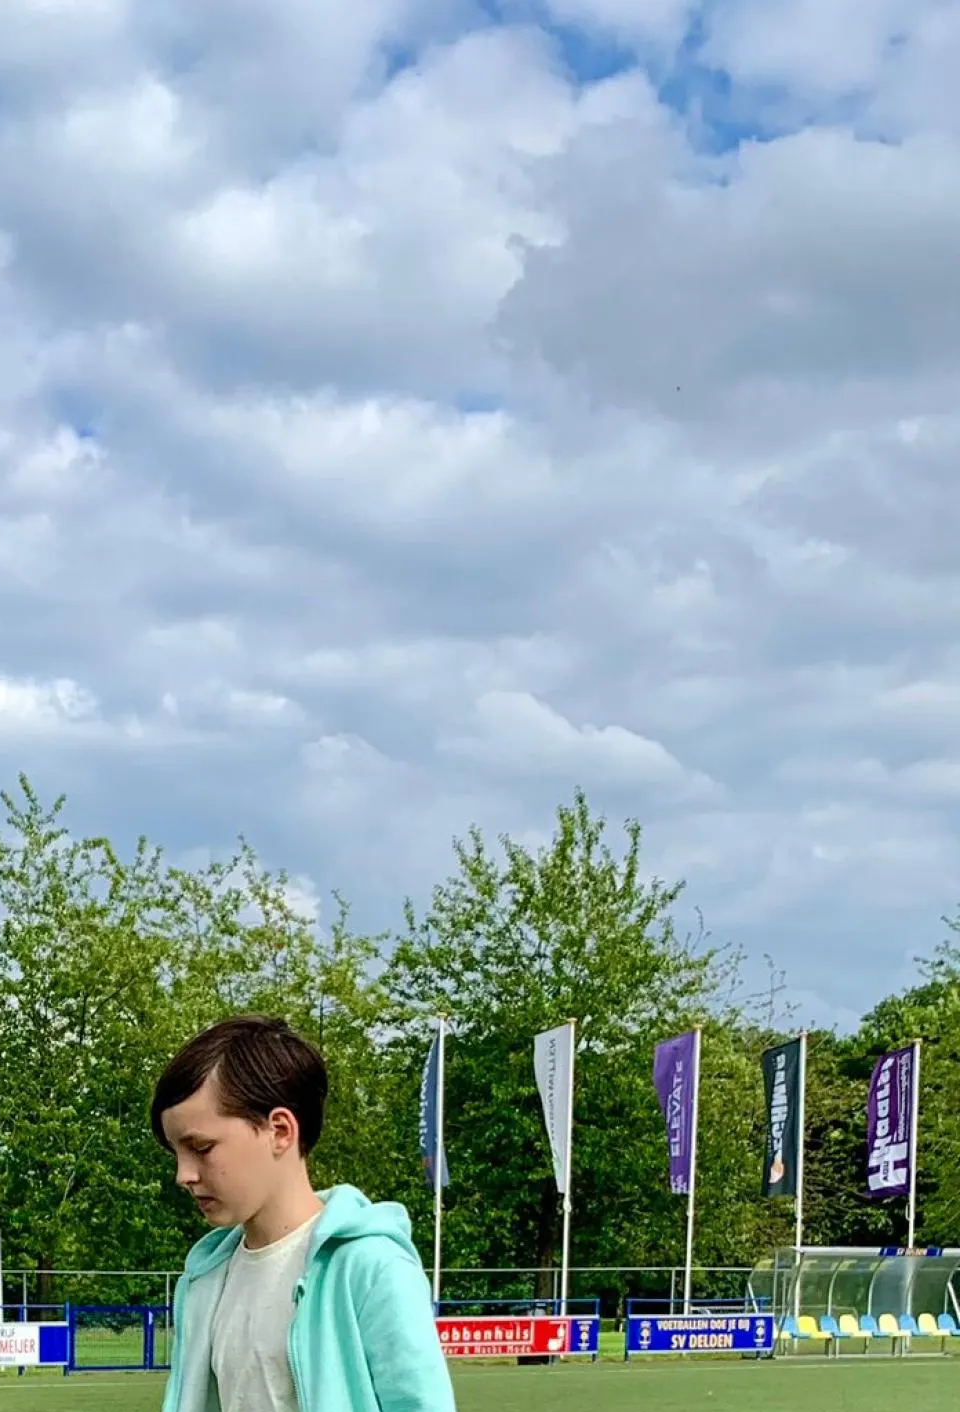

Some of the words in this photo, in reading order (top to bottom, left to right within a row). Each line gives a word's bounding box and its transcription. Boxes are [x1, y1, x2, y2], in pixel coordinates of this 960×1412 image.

[670, 1061, 684, 1157] ELEVATE
[440, 1323, 529, 1341] obbenhuis
[670, 1333, 687, 1349] SV
[689, 1333, 733, 1348] DELDEN
